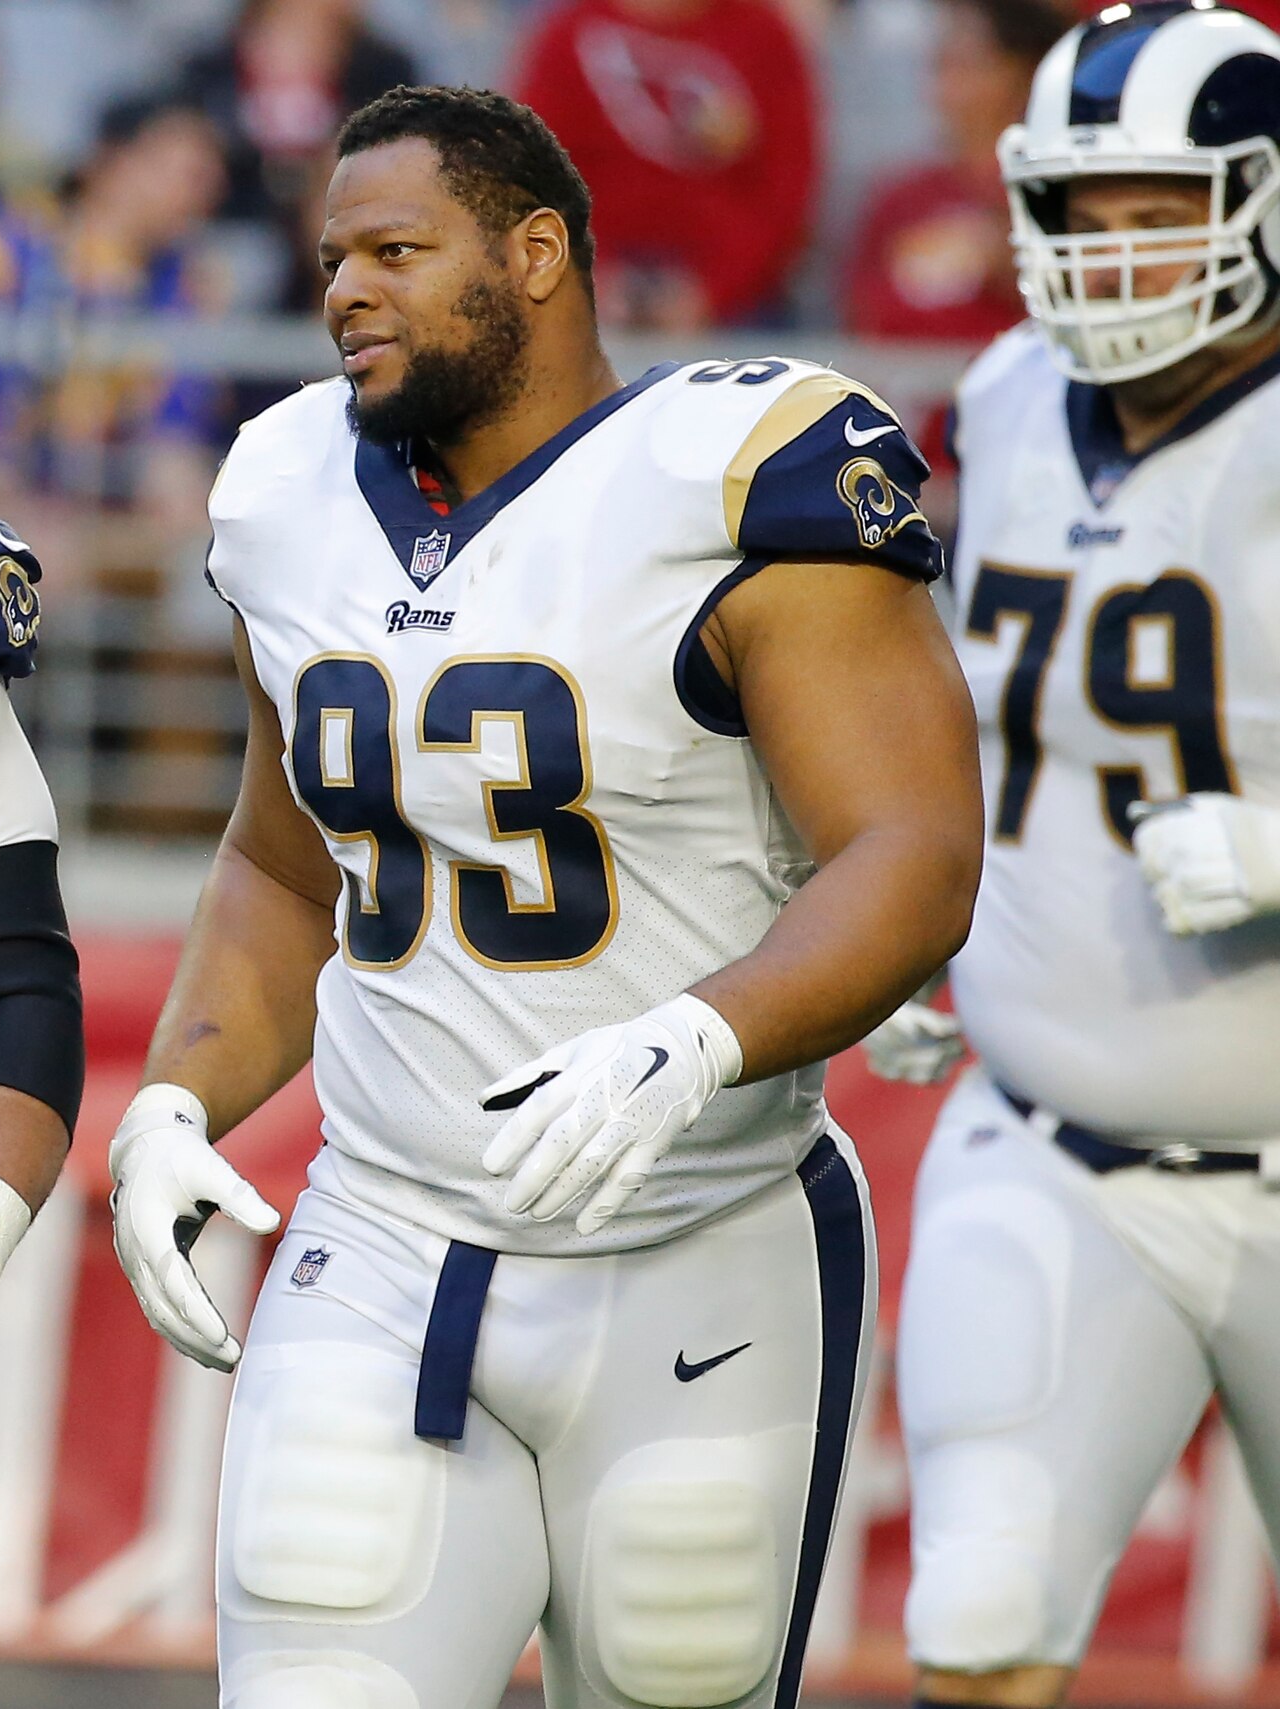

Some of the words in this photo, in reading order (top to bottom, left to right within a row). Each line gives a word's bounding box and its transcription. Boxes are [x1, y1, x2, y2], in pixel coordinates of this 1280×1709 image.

[385, 600, 457, 633] Rams
[415, 552, 441, 573] NFL
[966, 560, 1242, 855] 79
[288, 650, 620, 973] 93
